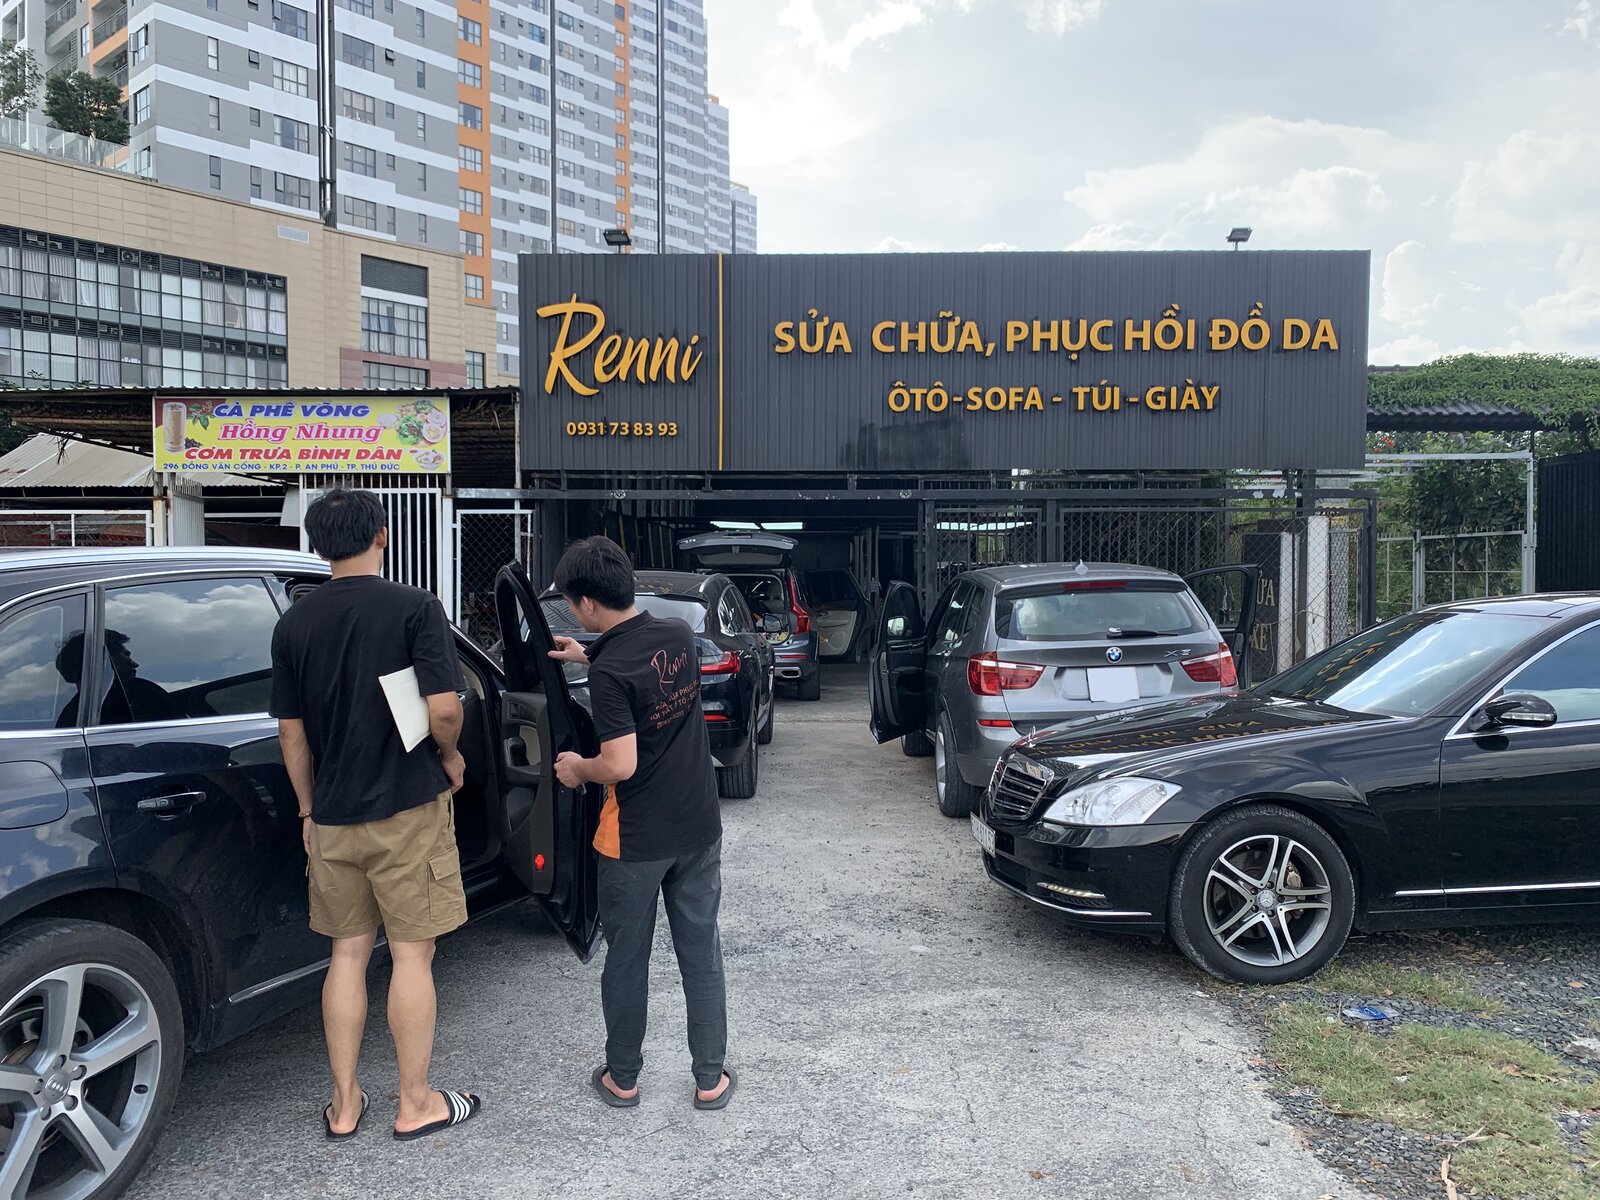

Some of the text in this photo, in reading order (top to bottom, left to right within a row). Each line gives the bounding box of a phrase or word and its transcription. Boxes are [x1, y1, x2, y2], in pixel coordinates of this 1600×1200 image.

[774, 302, 1339, 360] SỬA CHỮA, PHỤC HỒI ĐỒ DA
[536, 292, 702, 396] Renni
[214, 401, 371, 417] CÀ PHÊ VÕNG
[219, 418, 384, 443] Hồng Nhung
[566, 421, 678, 436] 0931 73 83 93
[185, 446, 402, 460] CƠM TRƯA BÌNH DÂN
